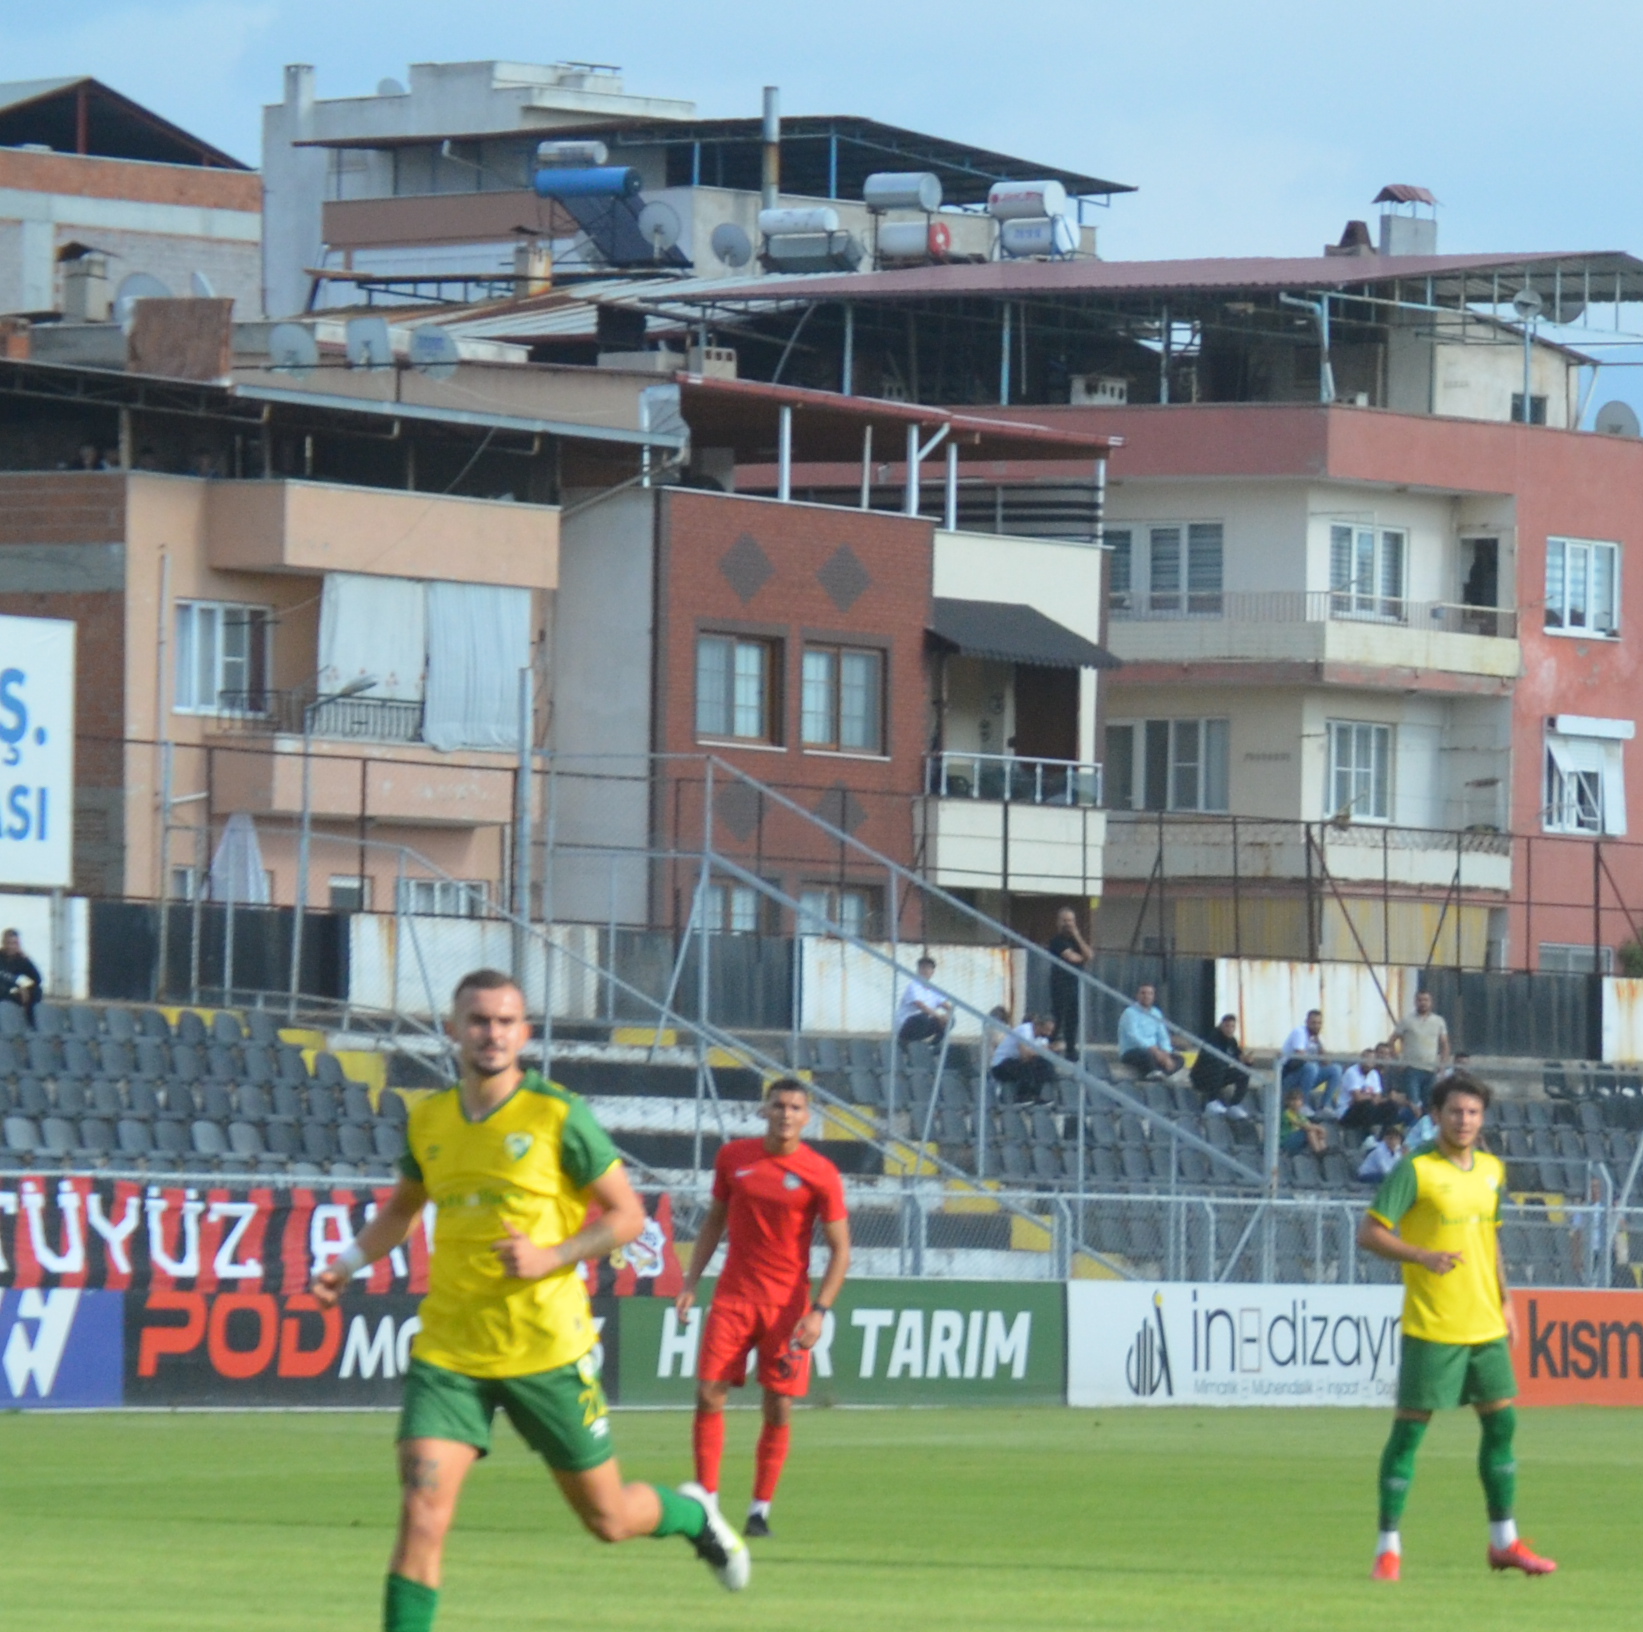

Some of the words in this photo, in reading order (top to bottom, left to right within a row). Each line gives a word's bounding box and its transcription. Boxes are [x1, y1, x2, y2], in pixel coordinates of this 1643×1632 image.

[0, 784, 48, 841] SI
[137, 1289, 343, 1380] POD
[851, 1310, 1032, 1380] TARIM
